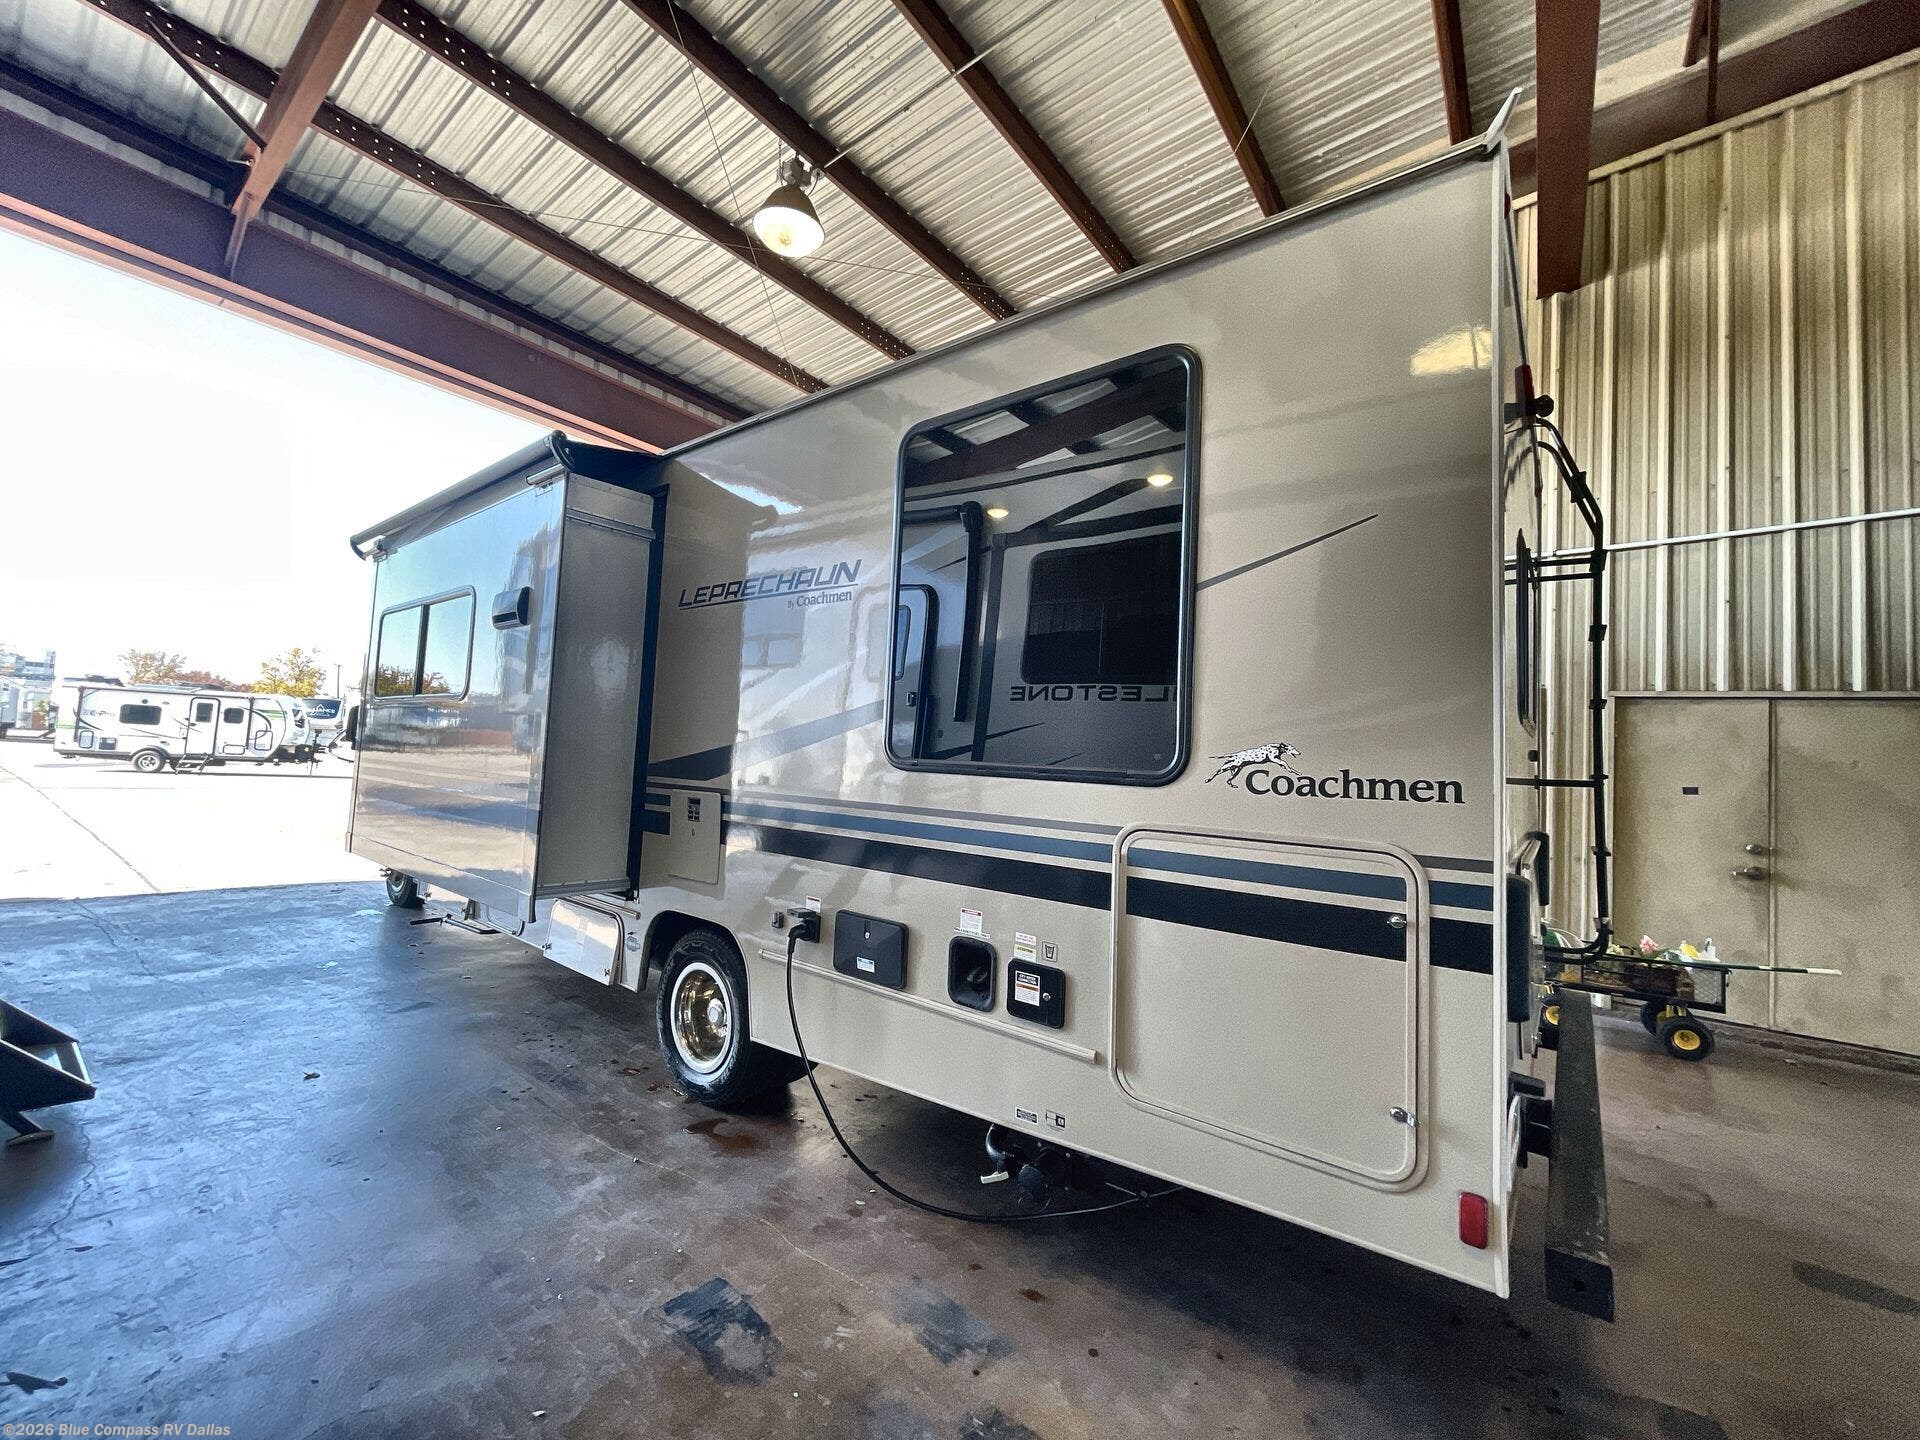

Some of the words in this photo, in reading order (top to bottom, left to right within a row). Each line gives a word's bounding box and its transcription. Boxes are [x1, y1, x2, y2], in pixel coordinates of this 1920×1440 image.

[678, 559, 862, 607] LEPRECHAUN
[796, 590, 852, 607] Coachmen
[1245, 769, 1465, 804] Coachmen
